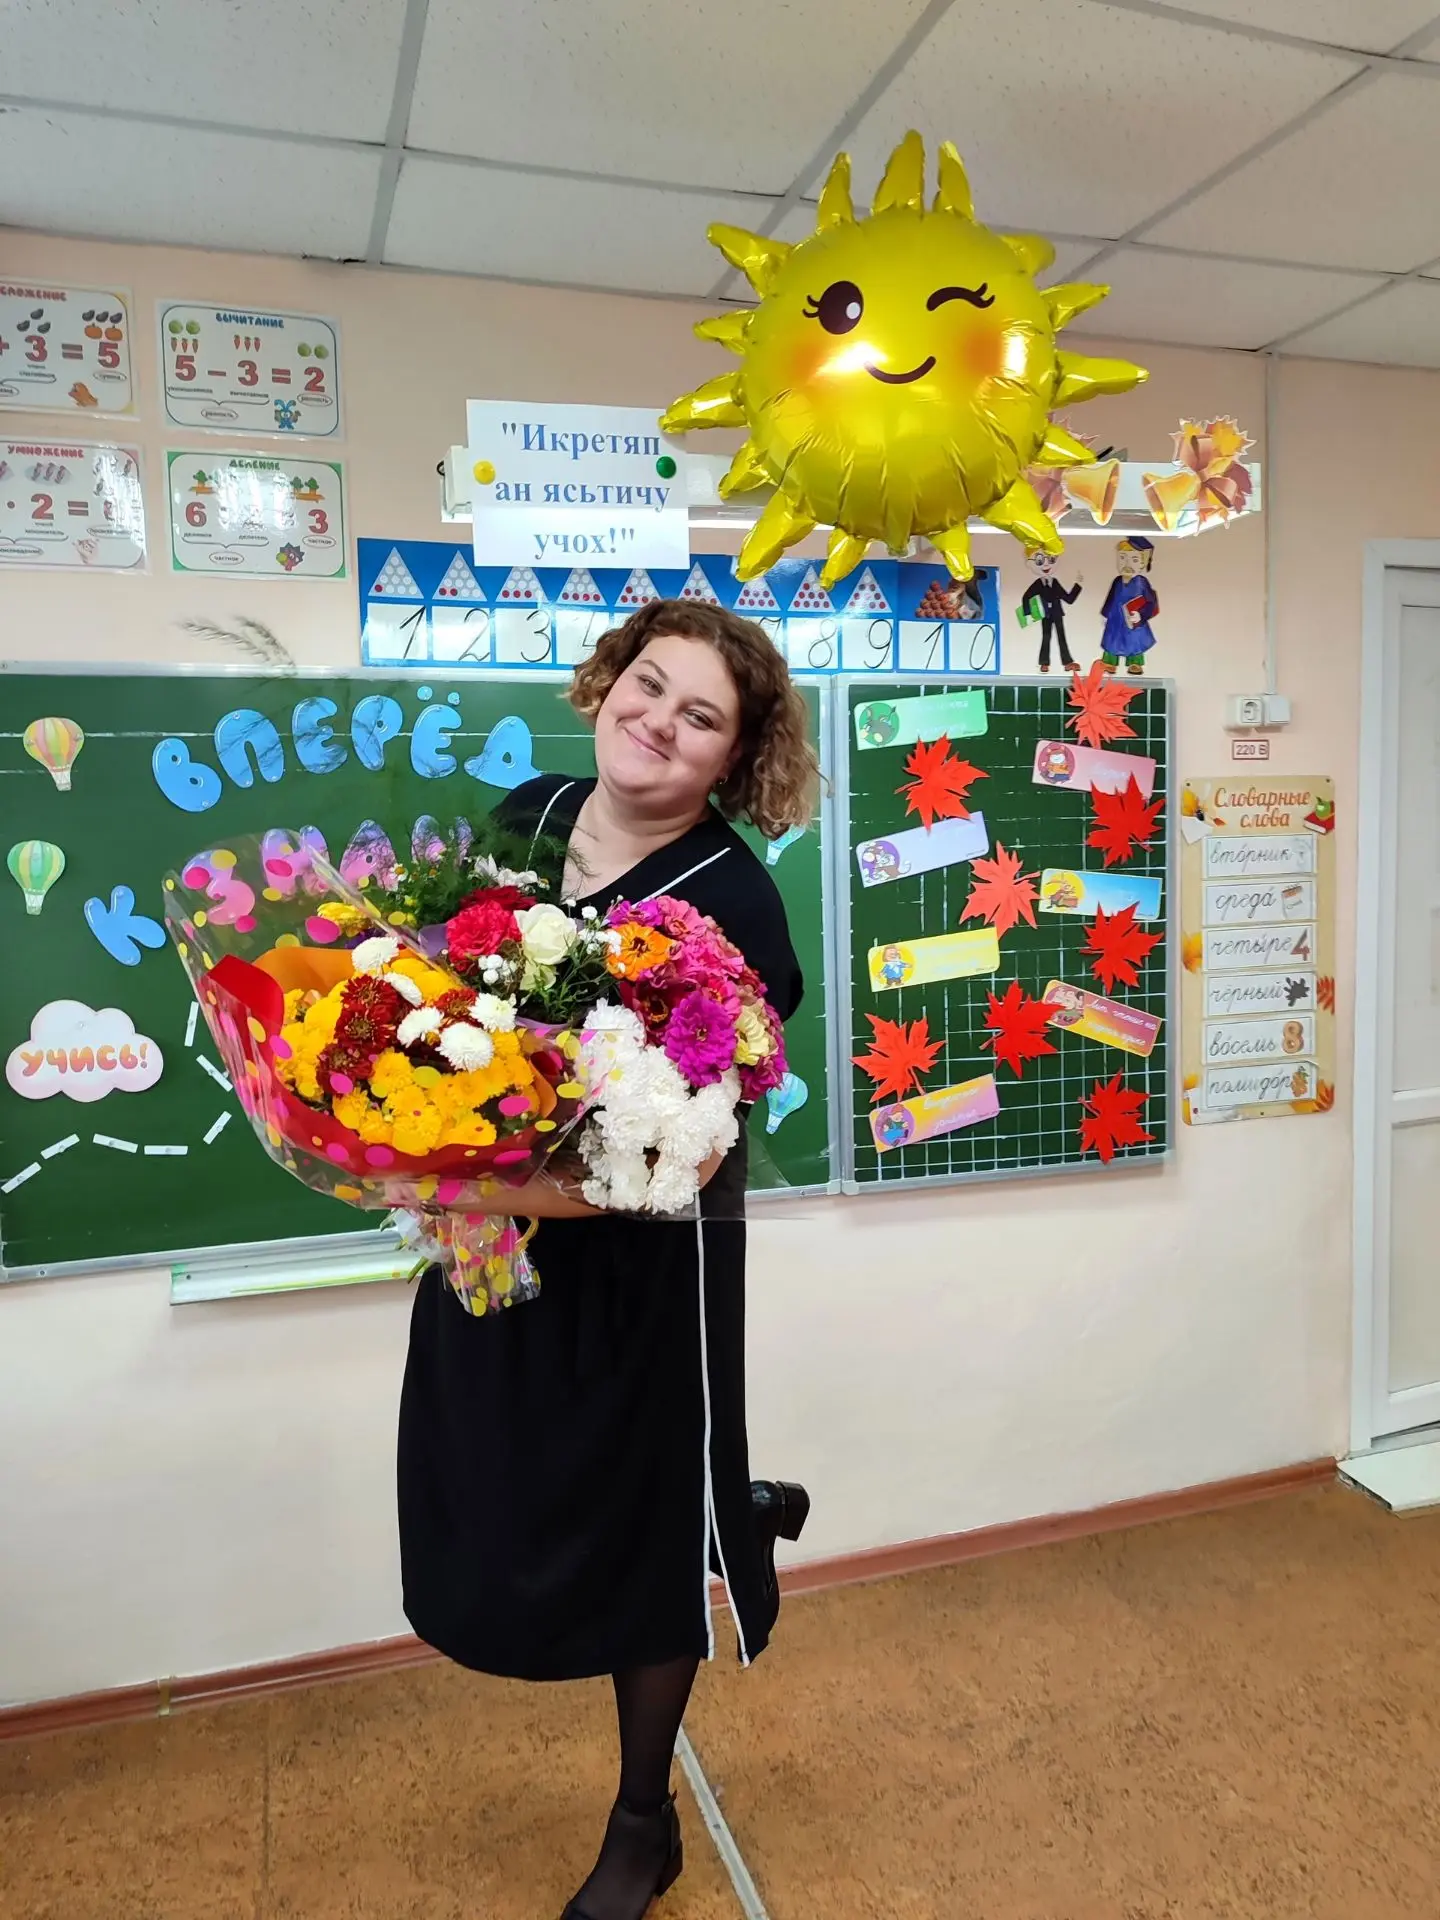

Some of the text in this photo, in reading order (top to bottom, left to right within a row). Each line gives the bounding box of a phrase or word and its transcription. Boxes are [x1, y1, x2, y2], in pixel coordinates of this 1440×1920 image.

[216, 312, 284, 329] ВЫЧИТАНИЕ
[25, 335, 48, 362] 3
[98, 341, 120, 368] 5
[175, 354, 197, 381] 5
[237, 359, 259, 386] 3
[304, 366, 326, 392] 2
[7, 445, 84, 459] УМНОЖЕНИЕ
[229, 459, 280, 471] ДЕЛЕНИЕ
[31, 493, 54, 520] 2
[495, 482, 671, 512] ан ясьтичу
[185, 501, 207, 528] 6
[308, 508, 329, 534] 3
[399, 604, 427, 660] 1
[458, 607, 491, 662] 2
[520, 609, 552, 664] 3
[807, 619, 838, 669] 8
[863, 618, 894, 669] 9
[151, 686, 543, 813] ВПЕРЁД
[1236, 744, 1256, 756] 220
[1214, 786, 1312, 813] Словарные
[1240, 808, 1290, 829] слова
[84, 885, 166, 966] К
[19, 1043, 149, 1077] УЧИСЬ!
